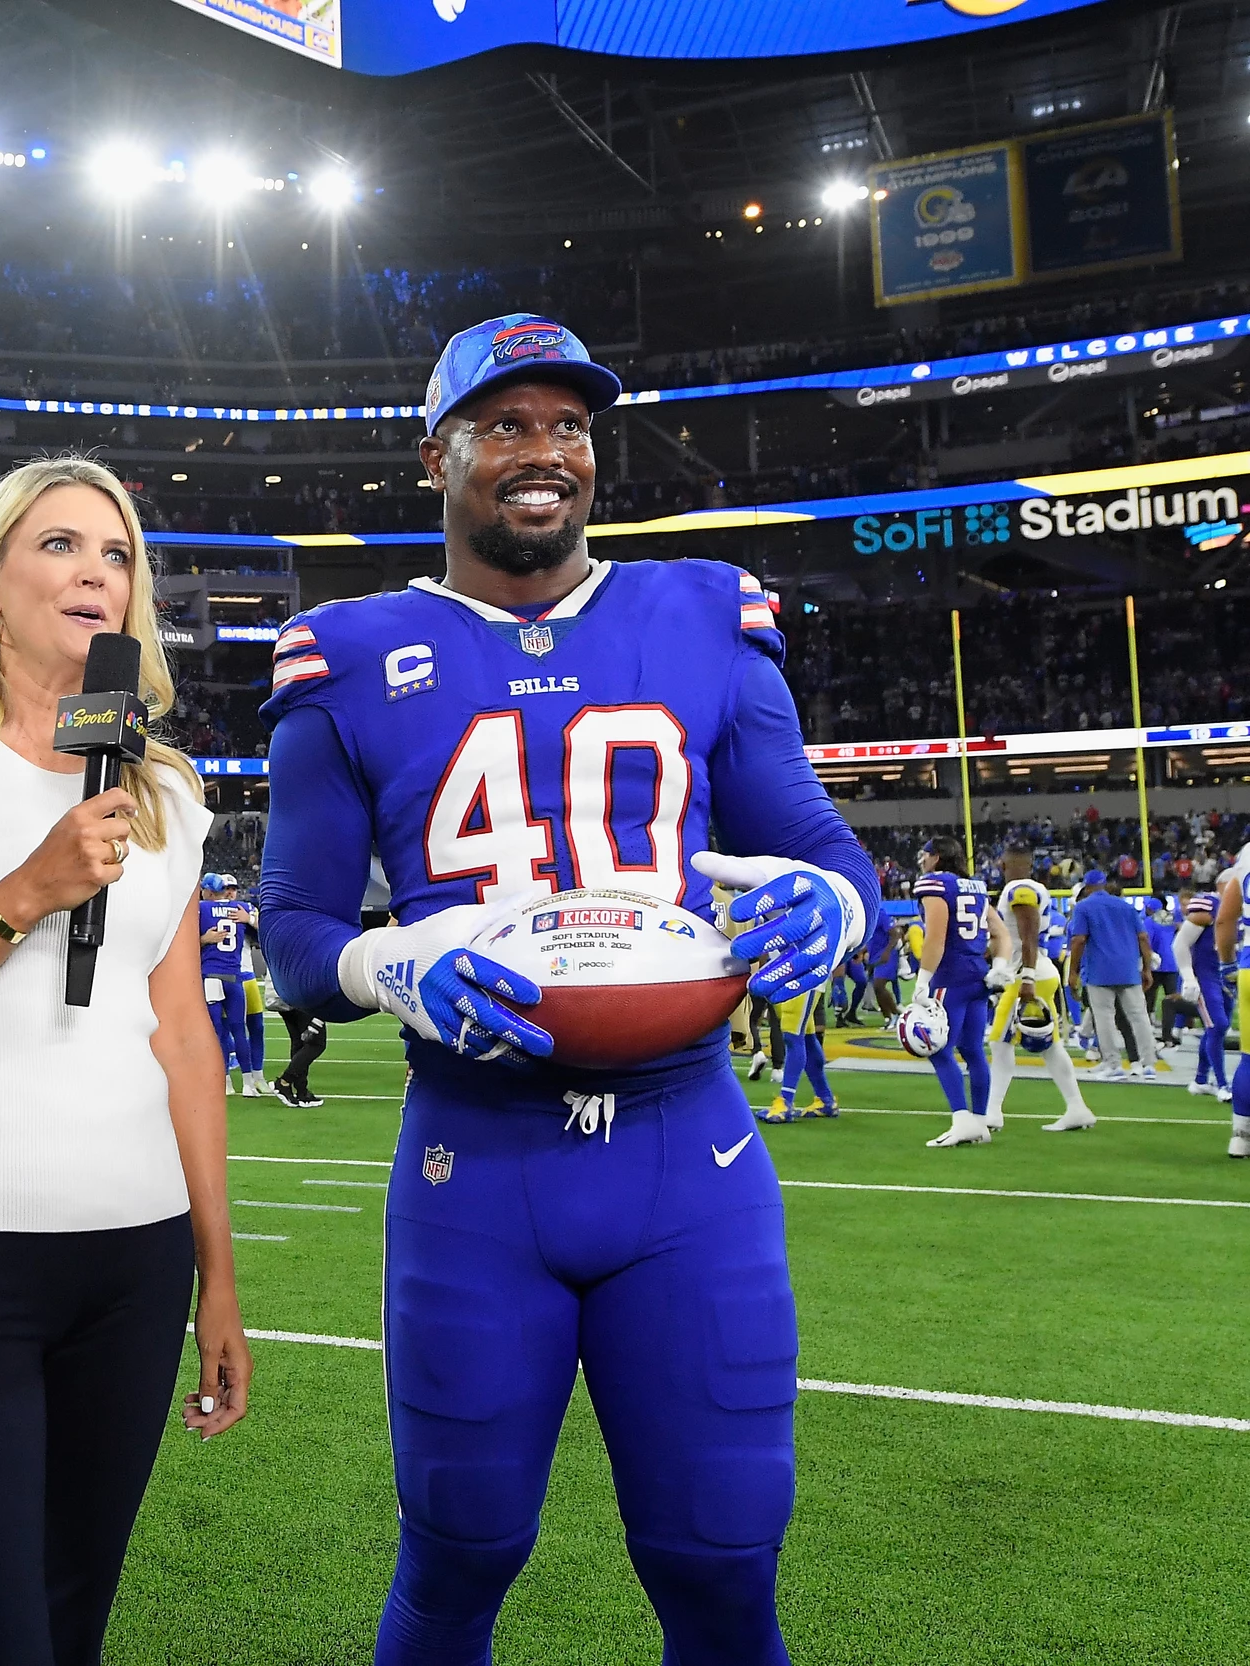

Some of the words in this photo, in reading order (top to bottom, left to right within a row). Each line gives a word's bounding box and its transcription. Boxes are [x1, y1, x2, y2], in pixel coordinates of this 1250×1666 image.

[1006, 326, 1194, 367] WELCOME
[1219, 318, 1250, 335] T
[1174, 343, 1214, 363] pepsi
[1069, 359, 1107, 378] pepsi
[971, 373, 1009, 391] pepsi
[875, 386, 911, 402] pepsi
[25, 400, 150, 417] WELCOME
[167, 406, 198, 419] TO
[213, 408, 258, 421] THE
[275, 408, 347, 421] RAMS
[853, 509, 954, 556] SoFi
[1019, 486, 1238, 541] Stadium
[165, 631, 195, 644] ULTRA
[526, 637, 549, 650] NFL
[384, 643, 434, 689] C
[508, 675, 581, 697] BILLS
[73, 708, 118, 729] Sports
[1190, 727, 1211, 741] 10
[192, 759, 242, 774] HE
[423, 702, 692, 905] 40
[562, 910, 630, 926] KICKOFF
[216, 919, 238, 952] 8
[552, 933, 573, 942] SOFI
[575, 931, 620, 940] STADIUM
[540, 941, 596, 953] SEPTEMBER
[598, 941, 608, 950] 8,
[610, 941, 632, 951] 2022
[550, 968, 568, 977] NBC
[376, 969, 418, 1014] adidas
[426, 1161, 447, 1179] NFL
